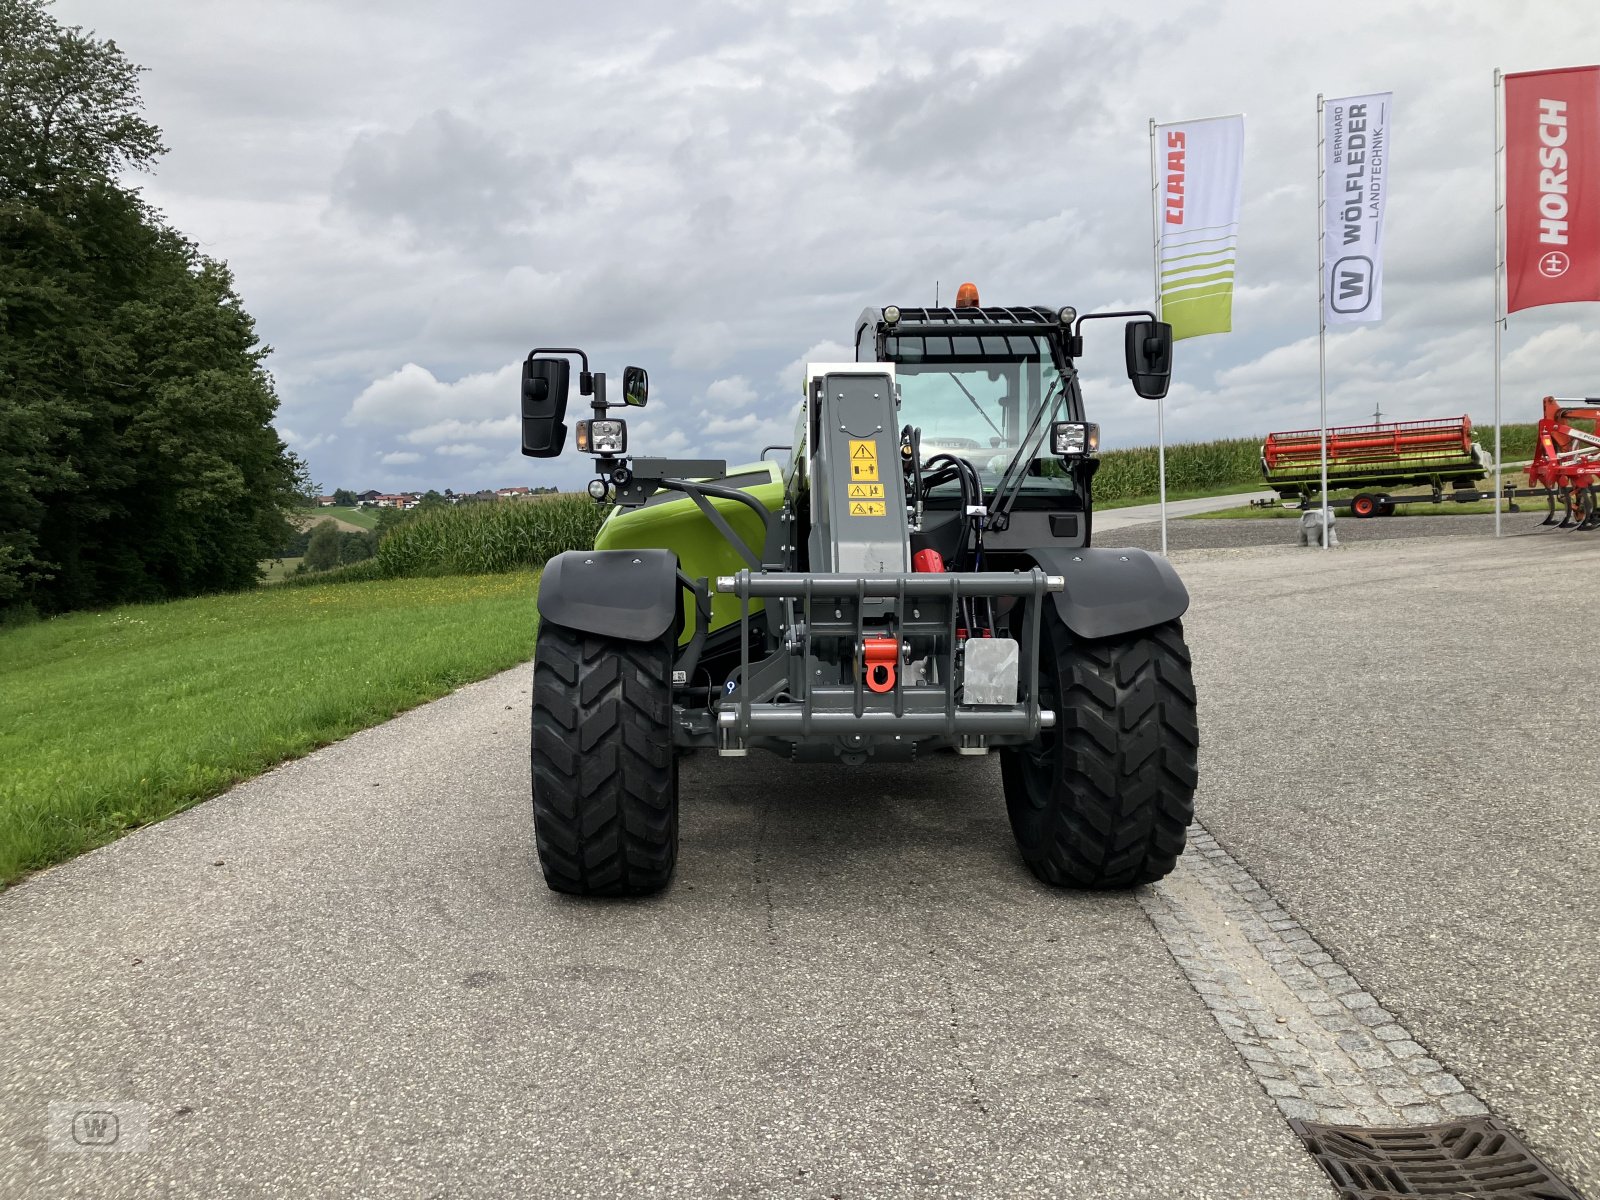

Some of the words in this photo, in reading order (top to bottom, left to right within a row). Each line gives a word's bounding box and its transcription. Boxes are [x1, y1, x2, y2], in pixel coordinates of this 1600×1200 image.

[1166, 131, 1185, 225] CLAAS
[1334, 106, 1343, 164] BERNHARD
[1341, 103, 1367, 246] WÖLFLEDER
[1369, 127, 1383, 219] LANDTECHNIK
[1539, 98, 1568, 245] HORSCH
[1339, 271, 1364, 300] W
